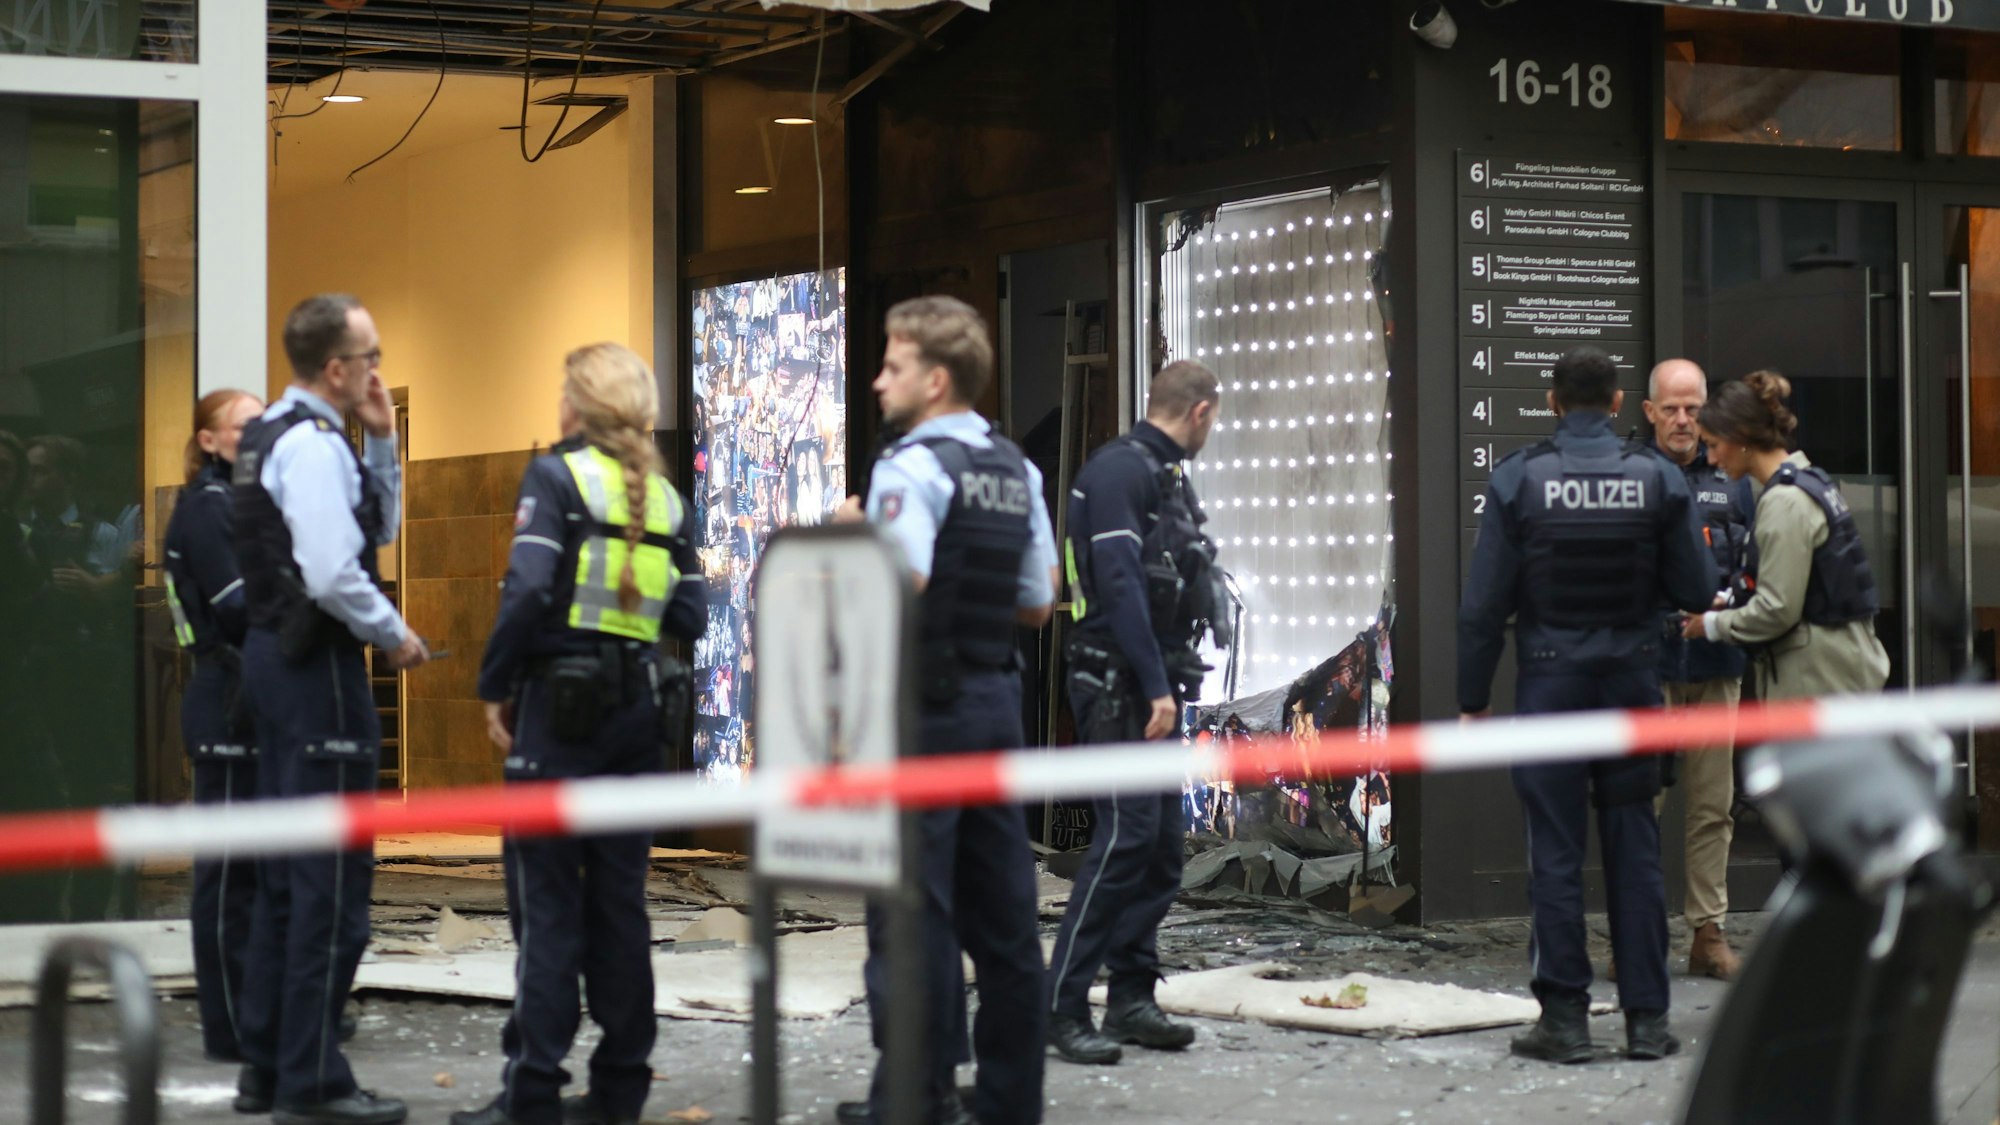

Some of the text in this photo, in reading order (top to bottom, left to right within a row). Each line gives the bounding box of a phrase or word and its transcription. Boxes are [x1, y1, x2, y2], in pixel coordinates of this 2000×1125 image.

[1489, 58, 1613, 109] 16-18
[1470, 163, 1484, 182] 6
[1515, 163, 1616, 175] Füngeling Immobilien Gruppe
[1523, 180, 1554, 188] Architekt
[1555, 181, 1579, 189] Farhad
[1623, 184, 1643, 192] GmbH
[1471, 210, 1484, 229] 6
[1505, 208, 1527, 218] Vanity
[1529, 209, 1550, 217] GmbH
[1580, 211, 1603, 219] Chicos
[1605, 212, 1625, 220] Event
[1505, 226, 1629, 239] Parookaville GmbH Cologne Clubbing
[1472, 257, 1485, 276] 5
[1497, 256, 1523, 264] Thomas
[1524, 257, 1544, 265] Group
[1545, 257, 1566, 265] GmbH
[1571, 259, 1597, 268] Spencer
[1615, 260, 1635, 268] GmbH
[1493, 272, 1510, 280] Book
[1511, 273, 1529, 282] Kings
[1530, 273, 1551, 281] GmbH
[1591, 276, 1617, 285] Cologne
[1619, 276, 1639, 284] GmbH
[1519, 297, 1548, 307] Nightlife
[1549, 298, 1593, 308] Management
[1472, 304, 1485, 324] 5
[1506, 311, 1538, 321] Flamingo
[1539, 312, 1558, 321] Royal
[1559, 312, 1580, 320] GmbH
[1534, 326, 1578, 336] Springinsfeld
[1472, 351, 1486, 370] 4
[1515, 351, 1536, 359] Effekt
[1537, 352, 1559, 360] Media
[1473, 401, 1486, 420] 4
[1518, 407, 1558, 416] Tradewin
[1473, 448, 1486, 467] 3
[960, 471, 1028, 515] POLIZE
[1545, 480, 1644, 509] POLIZEI
[1474, 495, 1486, 513] 2
